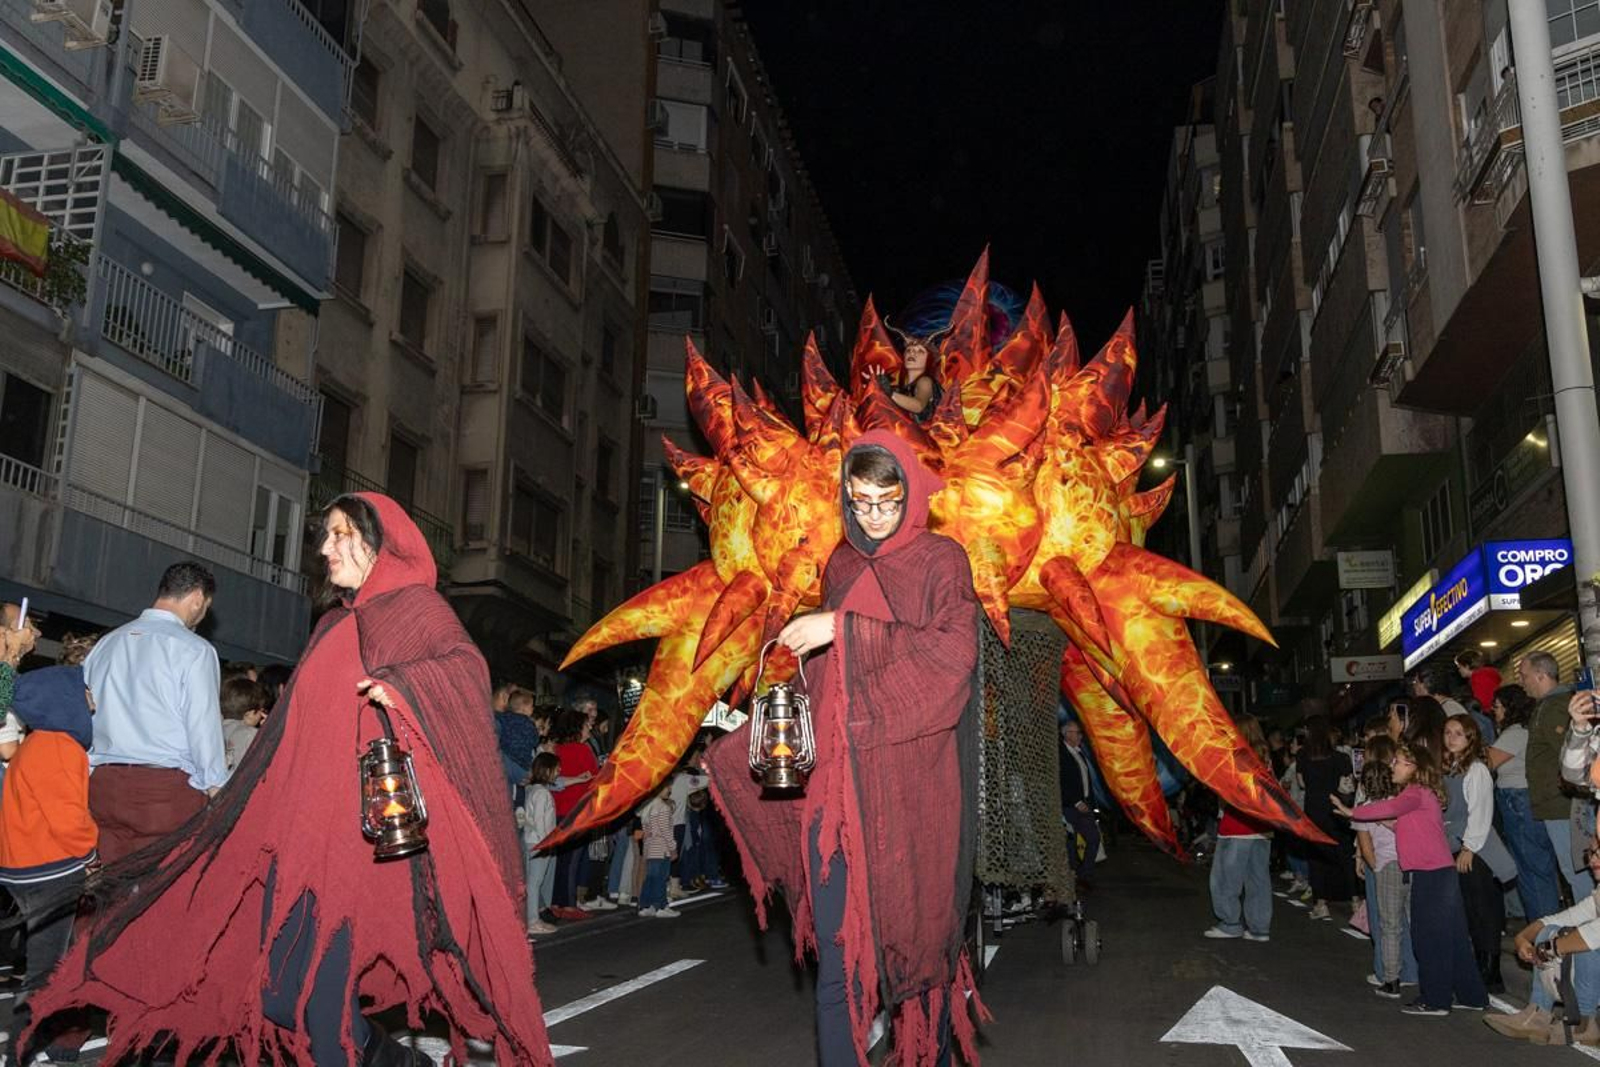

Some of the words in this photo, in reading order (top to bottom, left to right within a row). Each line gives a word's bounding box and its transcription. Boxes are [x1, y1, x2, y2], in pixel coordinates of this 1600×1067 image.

[1497, 549, 1568, 563] COMPRO
[1414, 608, 1433, 635] SUPER
[1436, 578, 1468, 618] EFECTIVO
